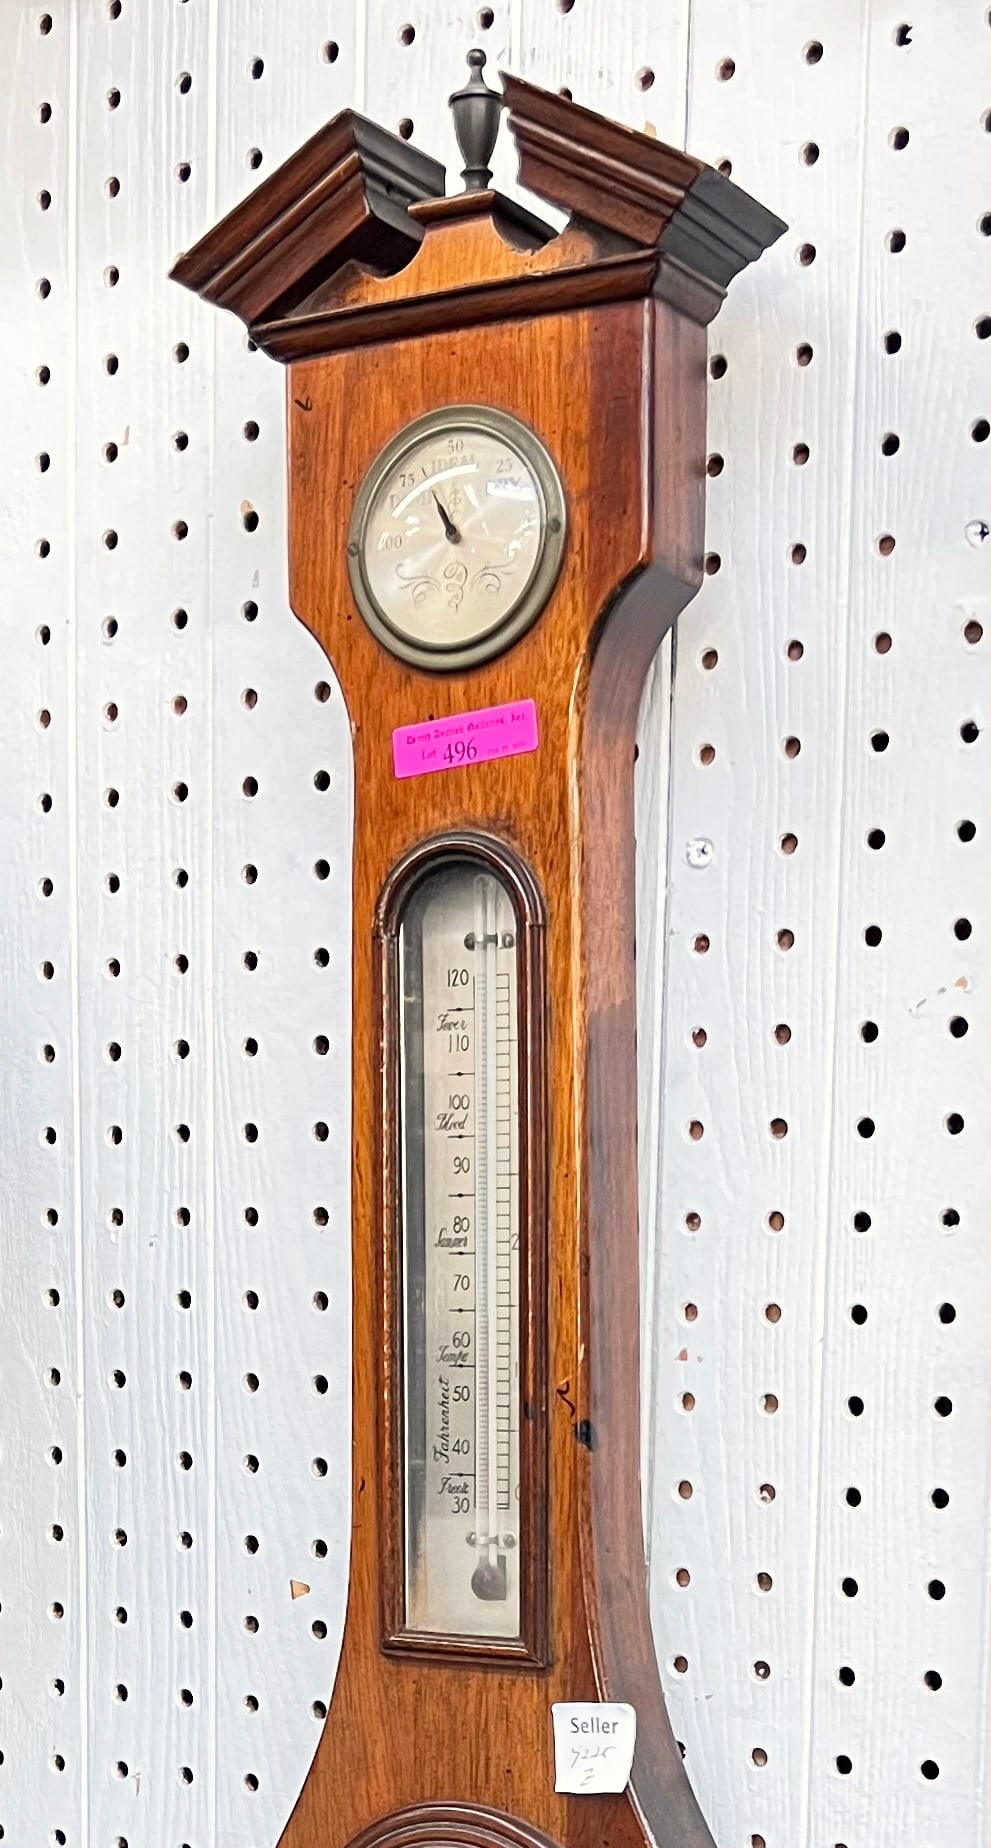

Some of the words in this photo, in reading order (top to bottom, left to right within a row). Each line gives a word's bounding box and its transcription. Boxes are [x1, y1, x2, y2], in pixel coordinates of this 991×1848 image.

[447, 439, 464, 451] 50
[431, 453, 479, 474] IDEAL
[496, 458, 513, 473] 25
[400, 473, 415, 487] 75
[443, 737, 477, 764] 496
[447, 969, 469, 987] 120
[448, 1034, 470, 1053] 110
[448, 1094, 470, 1110] 100
[453, 1156, 470, 1175] 90
[453, 1216, 470, 1234] 80
[453, 1274, 470, 1291] 70
[452, 1331, 470, 1348] 60
[452, 1385, 470, 1402] 50
[433, 1375, 450, 1464] Fahrenheit
[452, 1439, 470, 1455] 40
[451, 1496, 470, 1513] 30
[570, 1716, 618, 1734] Seller
